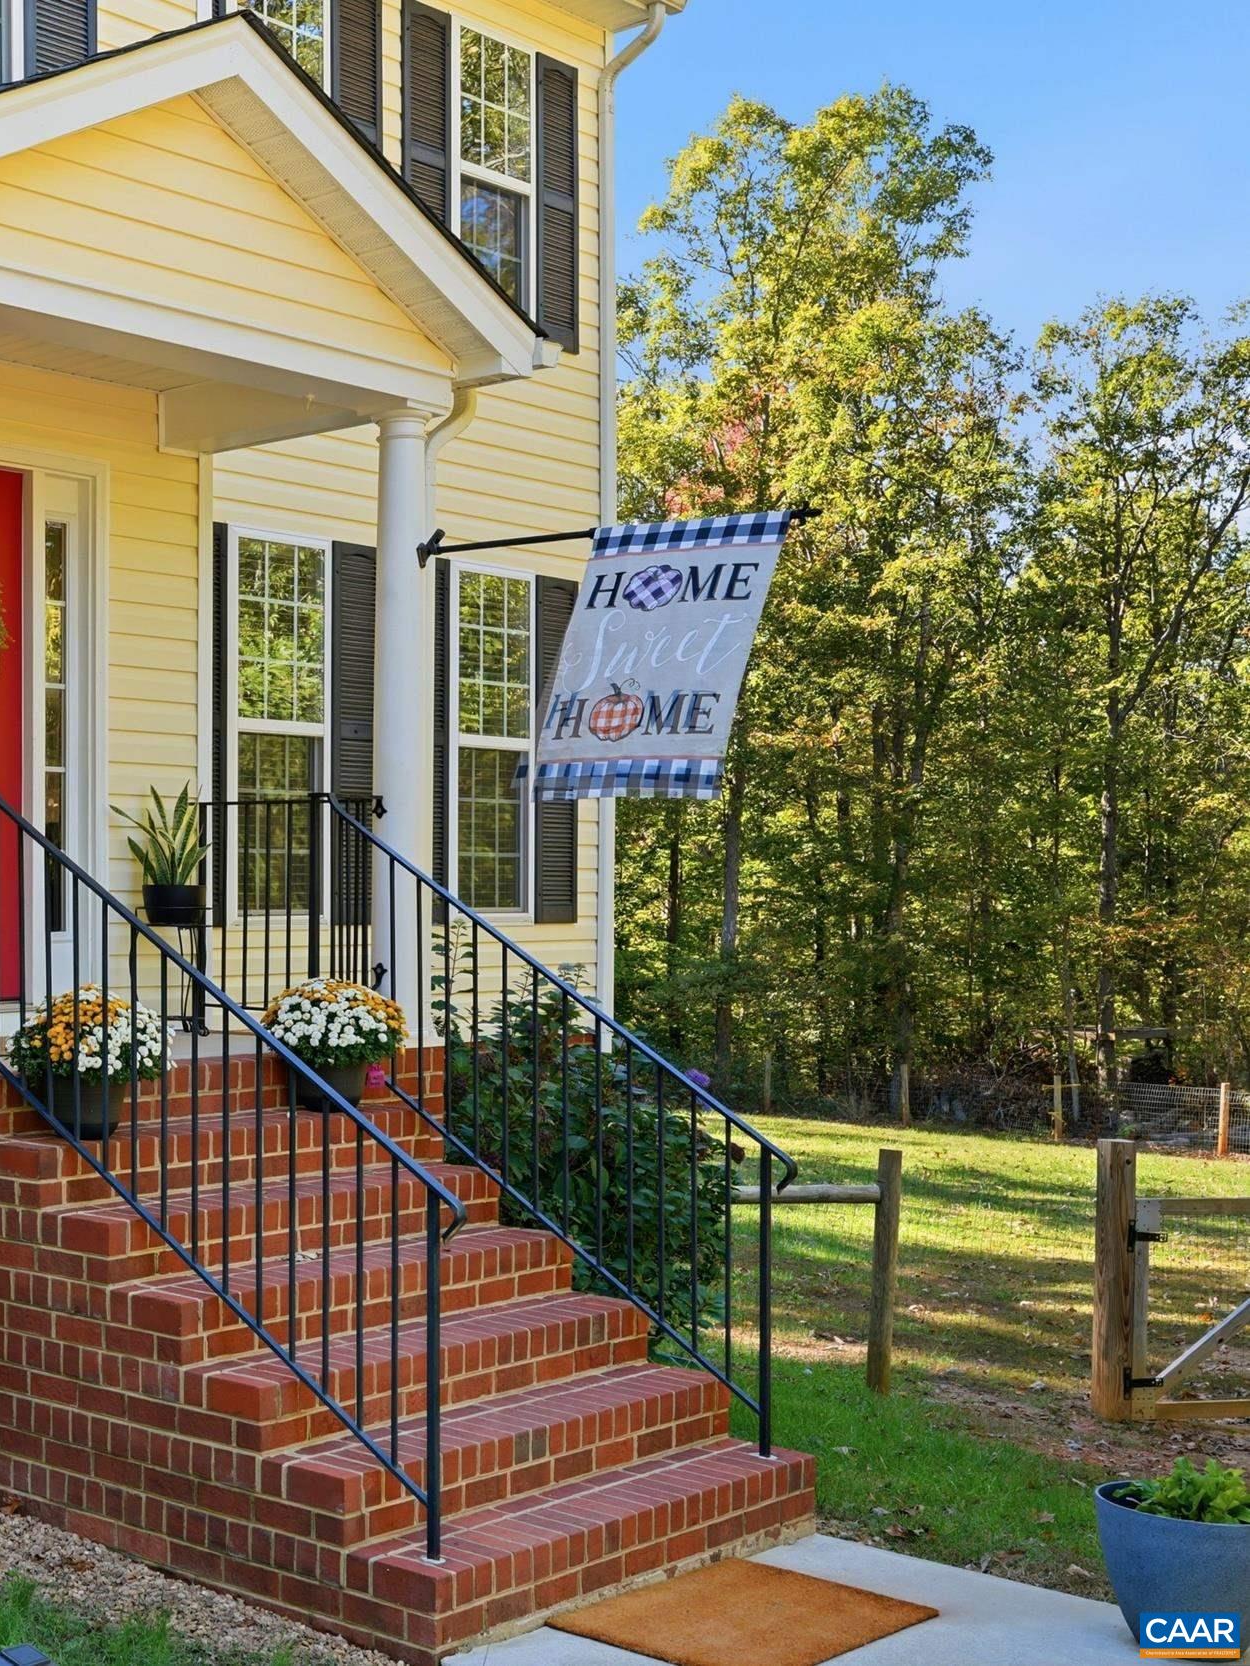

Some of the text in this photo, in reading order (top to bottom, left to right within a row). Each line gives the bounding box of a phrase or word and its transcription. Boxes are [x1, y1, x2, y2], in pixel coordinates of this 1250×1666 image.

[584, 562, 760, 611] HOME
[561, 609, 748, 693] Sweet
[549, 690, 721, 742] HOME
